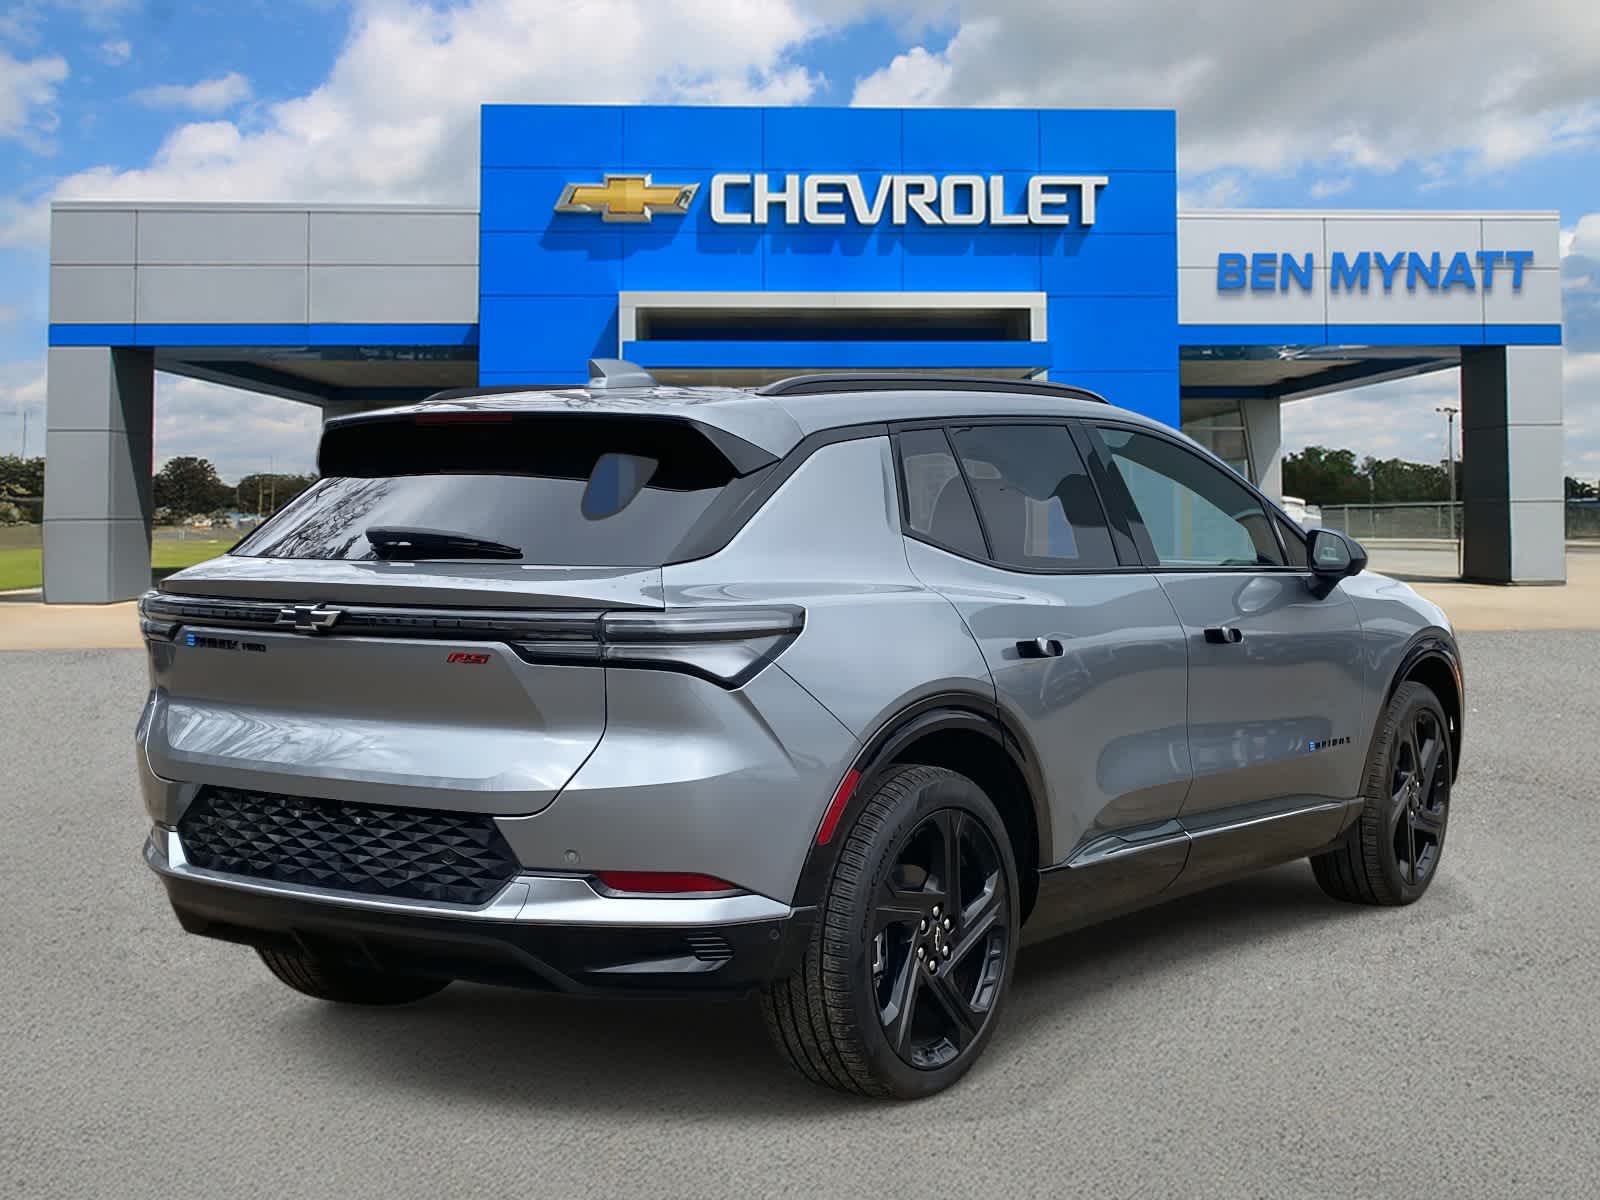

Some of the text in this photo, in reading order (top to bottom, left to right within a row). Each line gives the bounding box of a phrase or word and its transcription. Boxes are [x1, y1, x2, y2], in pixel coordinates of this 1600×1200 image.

[711, 173, 1109, 225] CHEVROLET
[1217, 250, 1534, 291] BEN MYNATT
